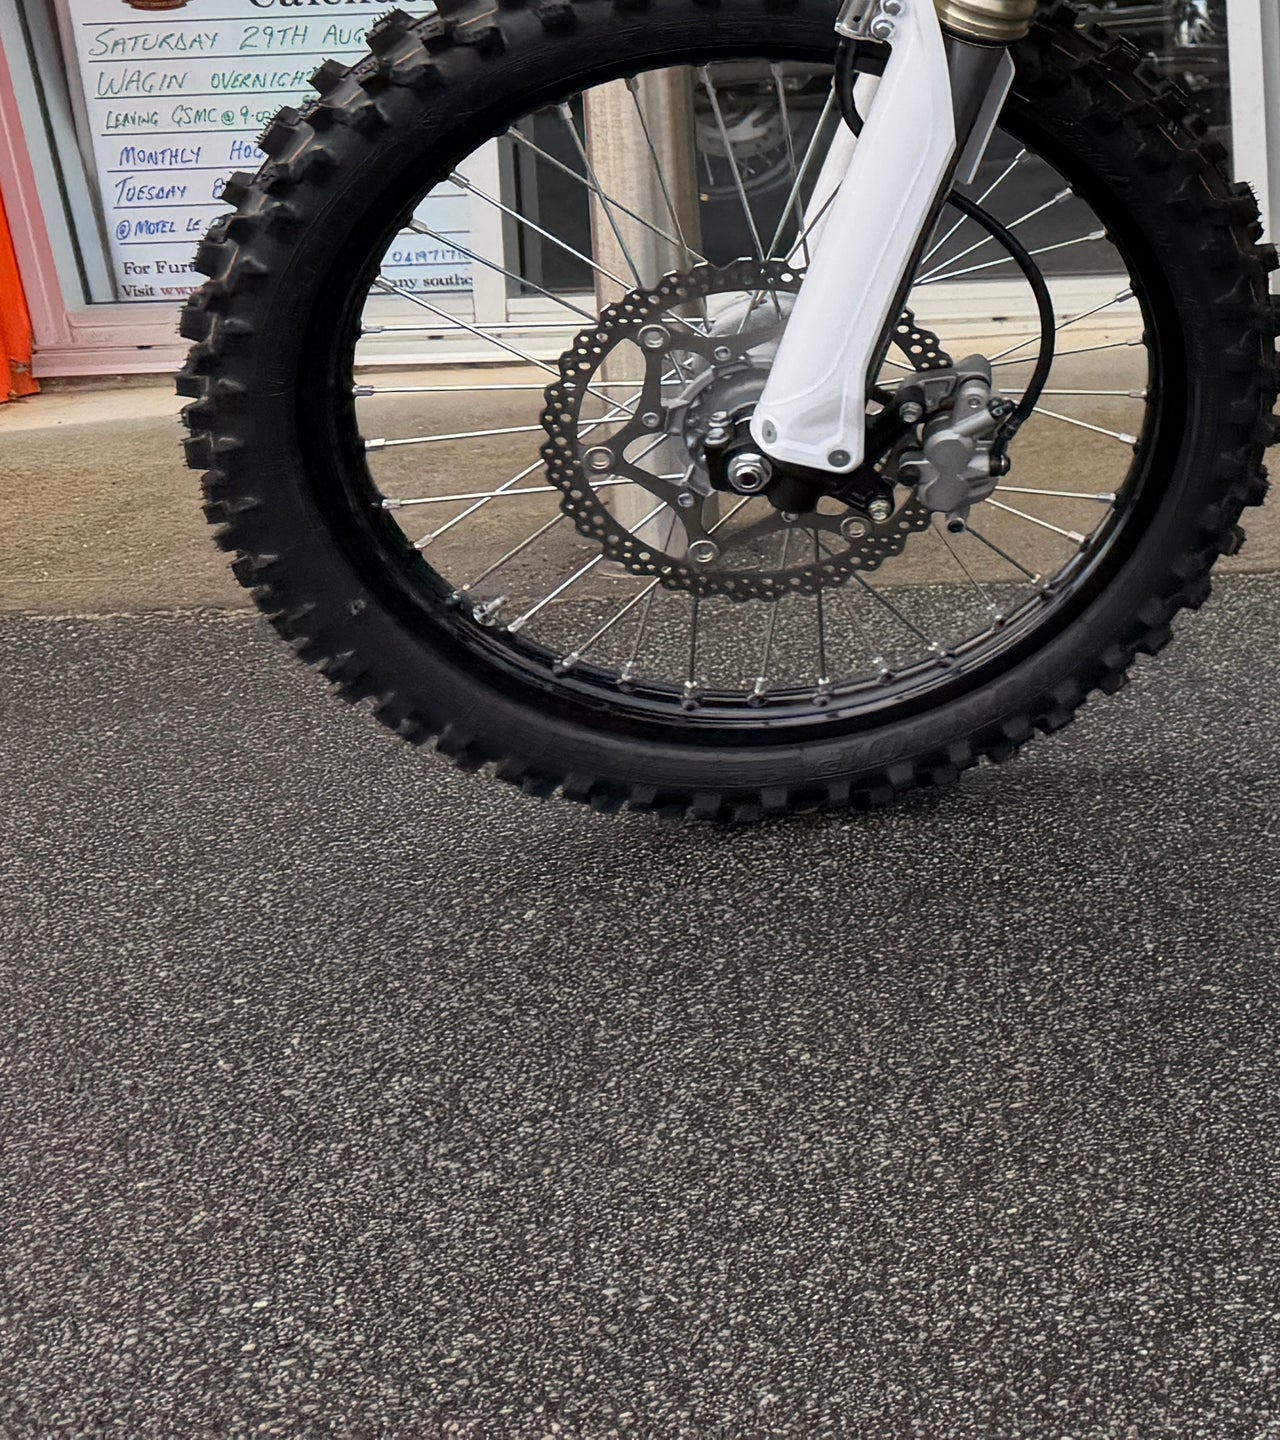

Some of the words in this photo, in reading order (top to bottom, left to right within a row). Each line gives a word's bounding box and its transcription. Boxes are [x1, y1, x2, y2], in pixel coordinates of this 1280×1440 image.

[88, 27, 218, 57] SATURDAY
[239, 25, 307, 52] 29TH
[97, 70, 188, 97] WAGIN
[106, 111, 158, 129] LEAVING
[119, 146, 202, 166] MONTHLY
[115, 176, 187, 205] TUESDAY
[135, 221, 176, 234] MOTEL
[124, 262, 150, 275] For
[121, 286, 155, 298] Visit
